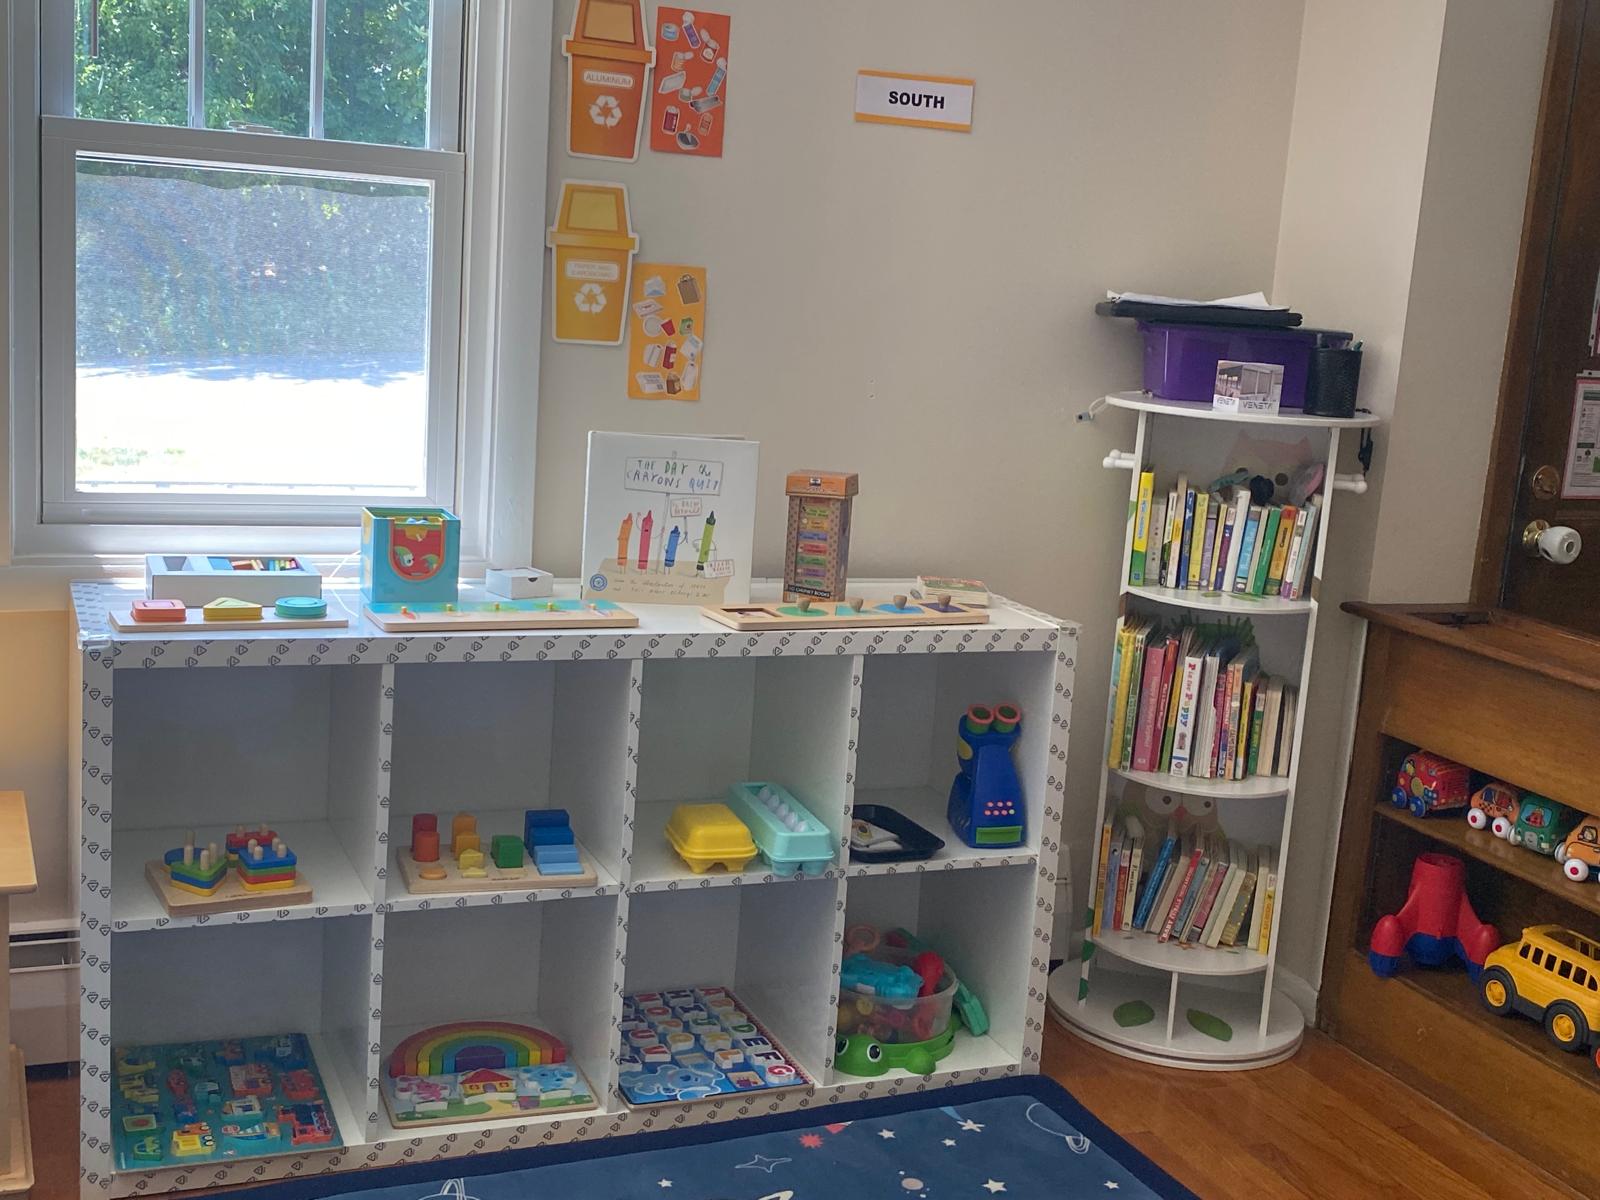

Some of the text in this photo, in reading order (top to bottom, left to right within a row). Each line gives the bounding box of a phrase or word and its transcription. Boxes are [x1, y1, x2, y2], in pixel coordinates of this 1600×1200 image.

[889, 91, 945, 109] SOUTH
[1243, 401, 1272, 409] VENETA
[638, 460, 656, 470] THE
[664, 461, 688, 475] DAY
[626, 470, 718, 492] CRAYONS QUIT
[1188, 663, 1196, 671] P
[1180, 692, 1193, 728] Puppy
